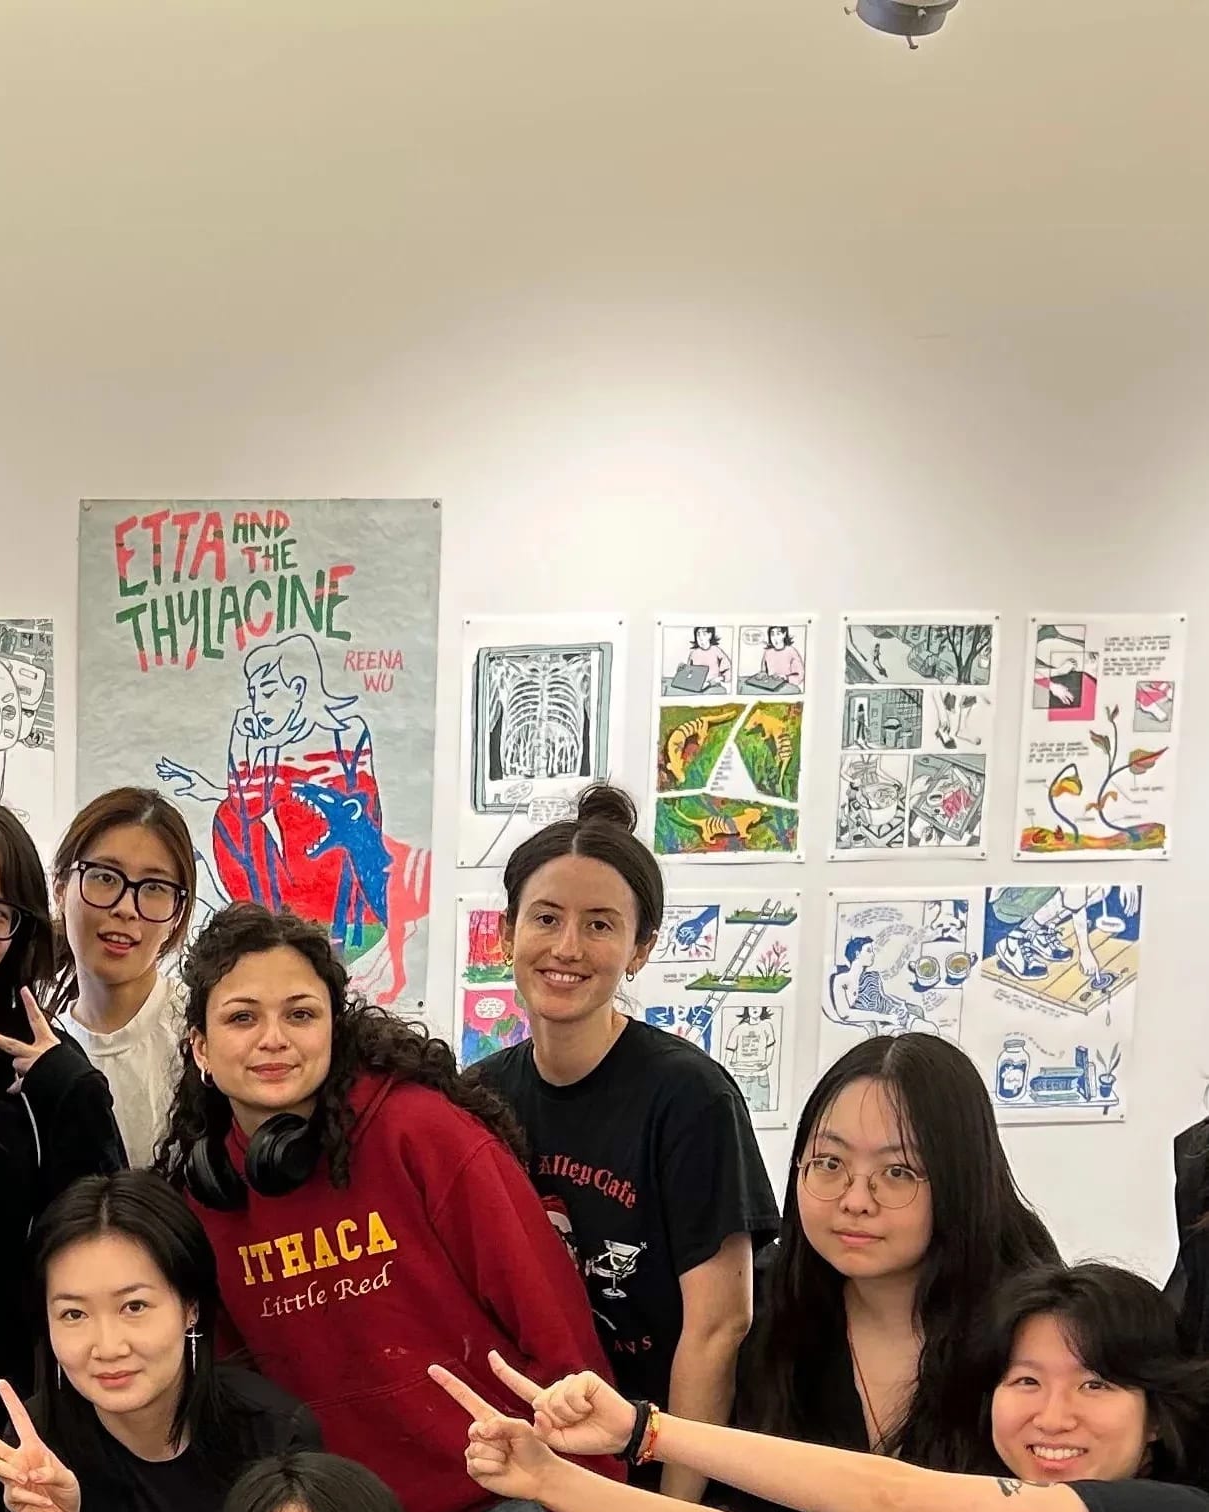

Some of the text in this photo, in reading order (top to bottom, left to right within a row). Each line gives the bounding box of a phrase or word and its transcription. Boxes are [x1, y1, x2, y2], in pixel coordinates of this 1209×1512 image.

[115, 509, 292, 597] ETTA AND
[241, 539, 298, 574] THE
[115, 565, 356, 672] THYLACINE
[343, 650, 404, 672] REENA
[363, 672, 395, 693] WU
[538, 1154, 593, 1186] Alley
[237, 1211, 398, 1286] ITHACA
[260, 1260, 394, 1318] Little Red
